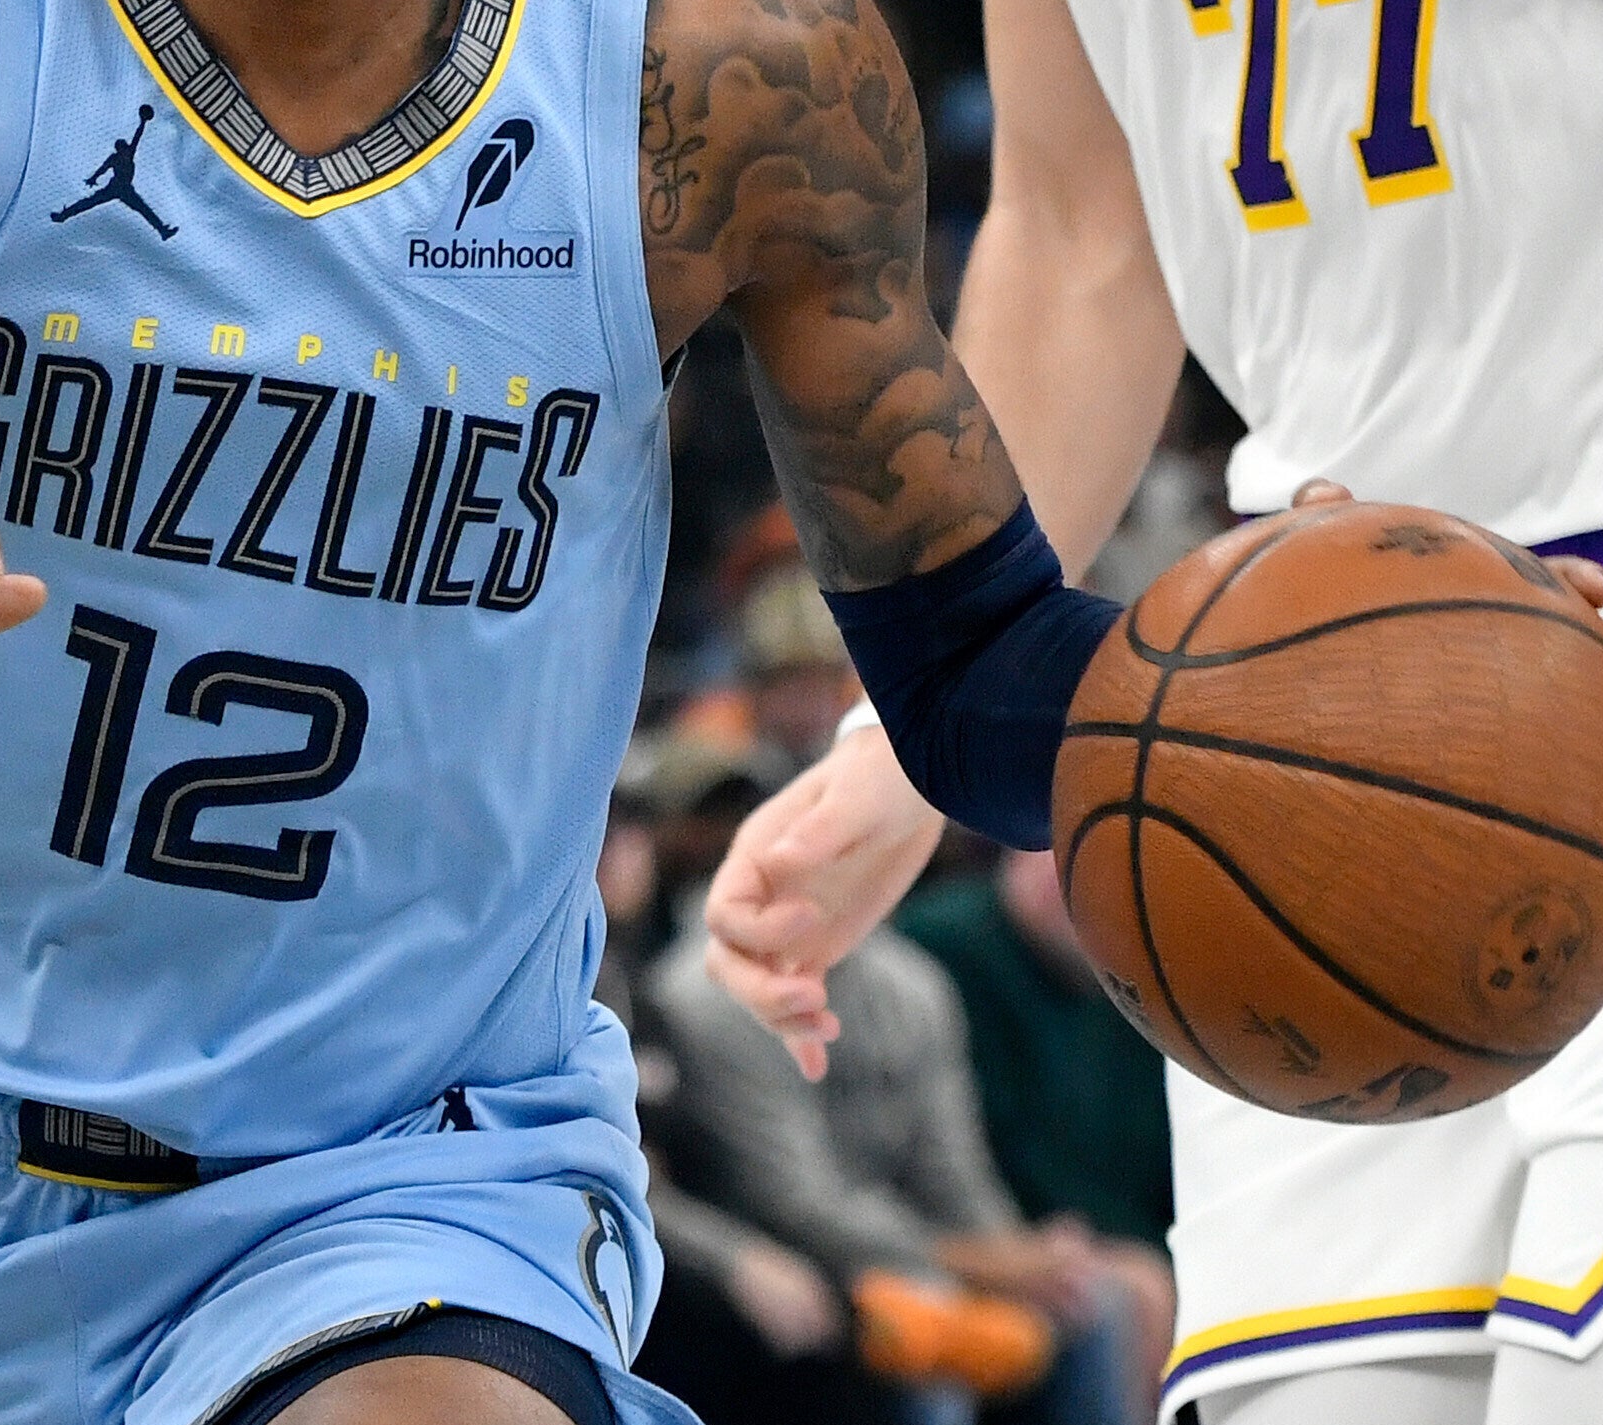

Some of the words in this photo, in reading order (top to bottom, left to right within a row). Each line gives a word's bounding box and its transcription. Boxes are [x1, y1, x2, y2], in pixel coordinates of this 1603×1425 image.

[408, 238, 574, 269] Robinhood
[44, 313, 530, 407] MEMPHIS
[49, 603, 370, 902] 12
